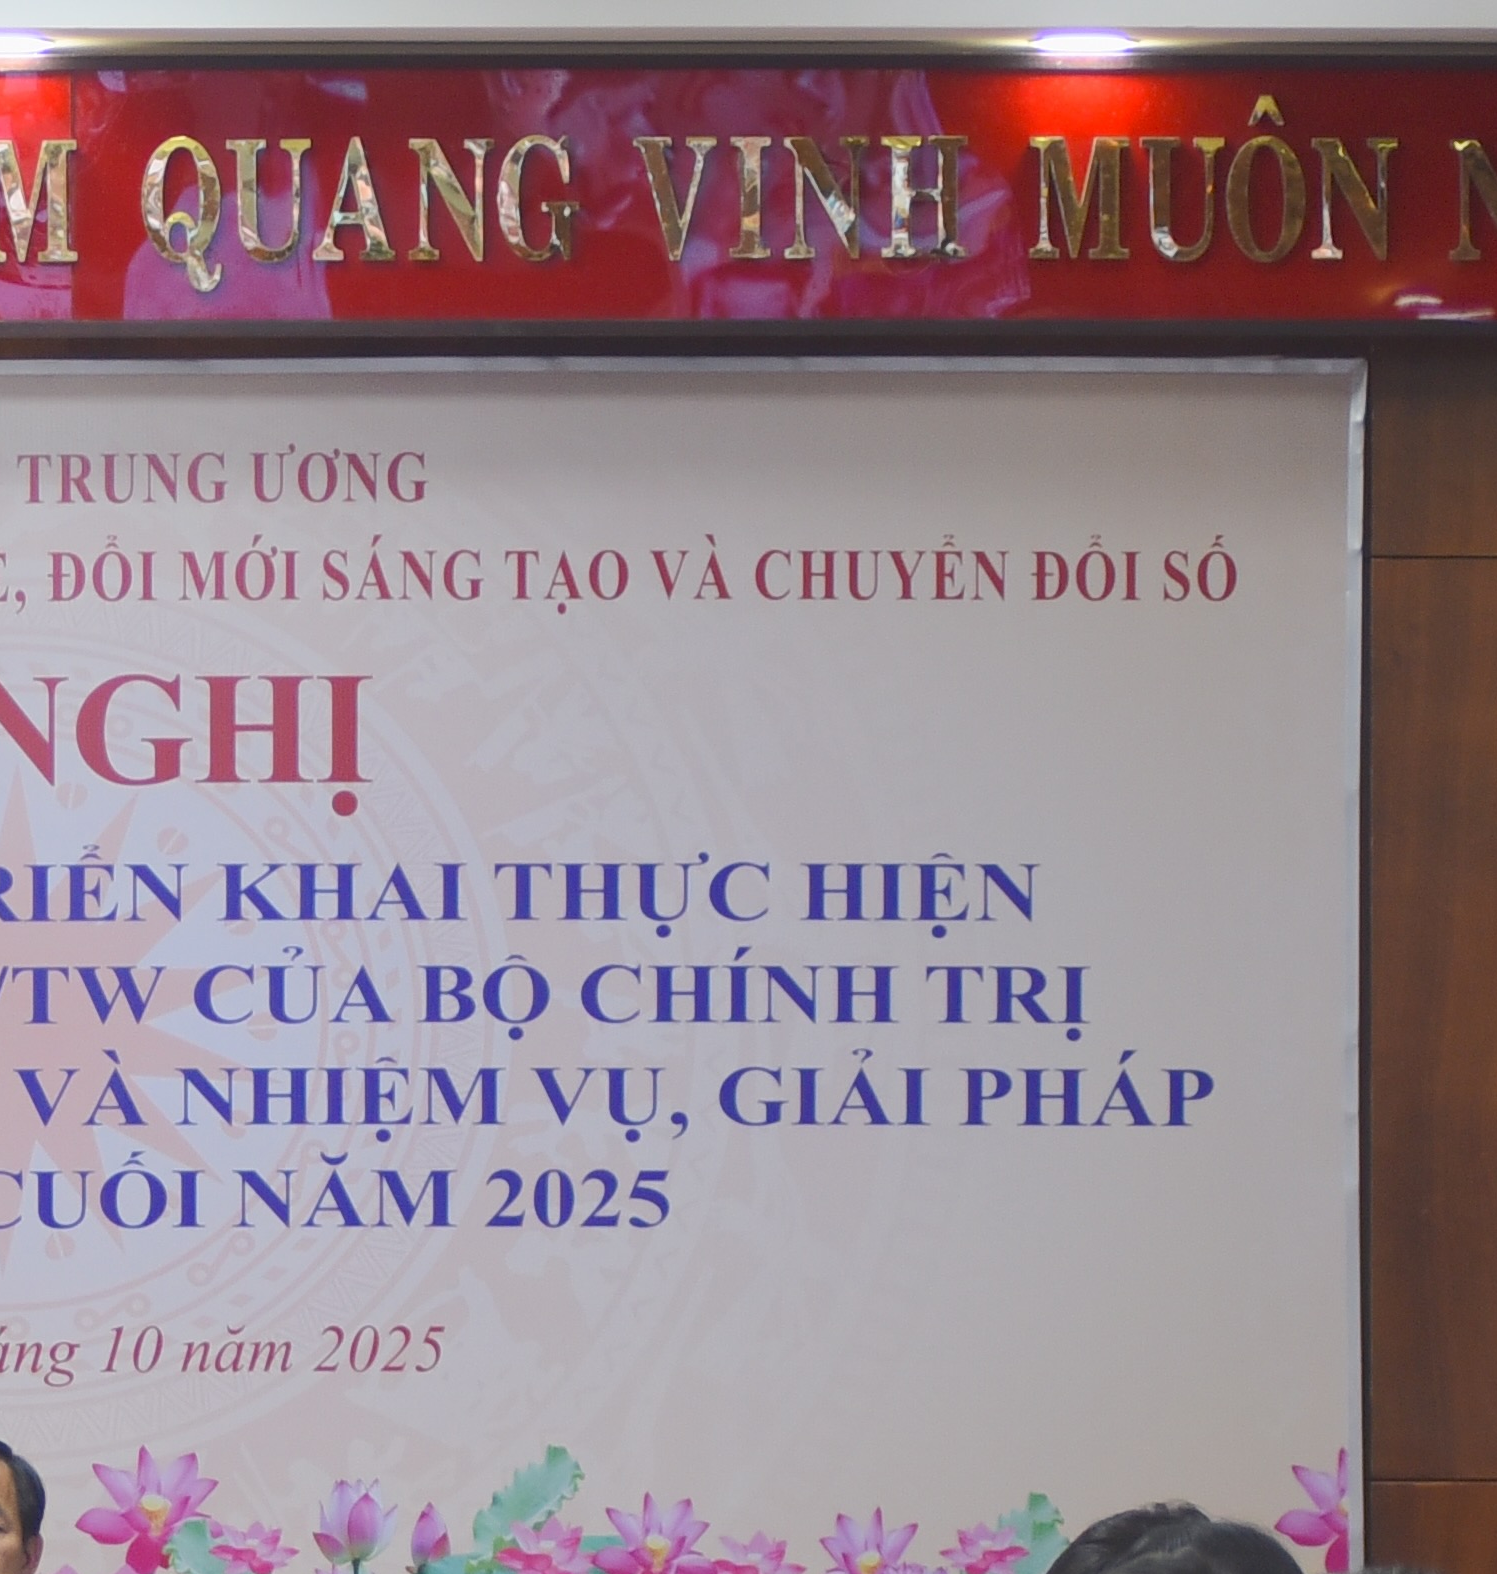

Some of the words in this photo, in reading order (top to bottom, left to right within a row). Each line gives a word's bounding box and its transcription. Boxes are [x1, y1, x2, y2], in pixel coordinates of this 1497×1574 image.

[141, 135, 575, 294] QUANG
[633, 135, 968, 263] VINH
[1028, 94, 1395, 263] MUÔN
[13, 450, 230, 505] TRUNG
[249, 442, 429, 504] ƯƠNG
[47, 535, 157, 603] ĐỔI
[179, 533, 299, 602] MỚI
[319, 533, 485, 601] SÁNG
[502, 549, 632, 616] TẠO
[649, 532, 733, 601] VÀ
[751, 534, 1008, 602] CHUYỂN
[1030, 535, 1141, 602] ĐỔI
[1160, 534, 1241, 602] SỐ
[221, 862, 464, 922] KHAI
[491, 851, 773, 940] THỰC
[803, 852, 1038, 940] HIỆN
[190, 946, 396, 1025] CỦA
[421, 954, 553, 1042] BỘ
[577, 945, 896, 1025] CHÍNH
[922, 965, 1087, 1043] TRỊ
[14, 1048, 148, 1127] VÀ
[176, 1056, 502, 1144] NHIỆM
[531, 1066, 692, 1144] VỤ,
[715, 1048, 927, 1127] GIẢI
[962, 1048, 1217, 1128] PHÁP
[235, 1152, 453, 1229] NĂM
[483, 1168, 673, 1230] 2025
[101, 1325, 167, 1374] 10
[178, 1326, 295, 1374] năm
[311, 1323, 448, 1374] 2025
